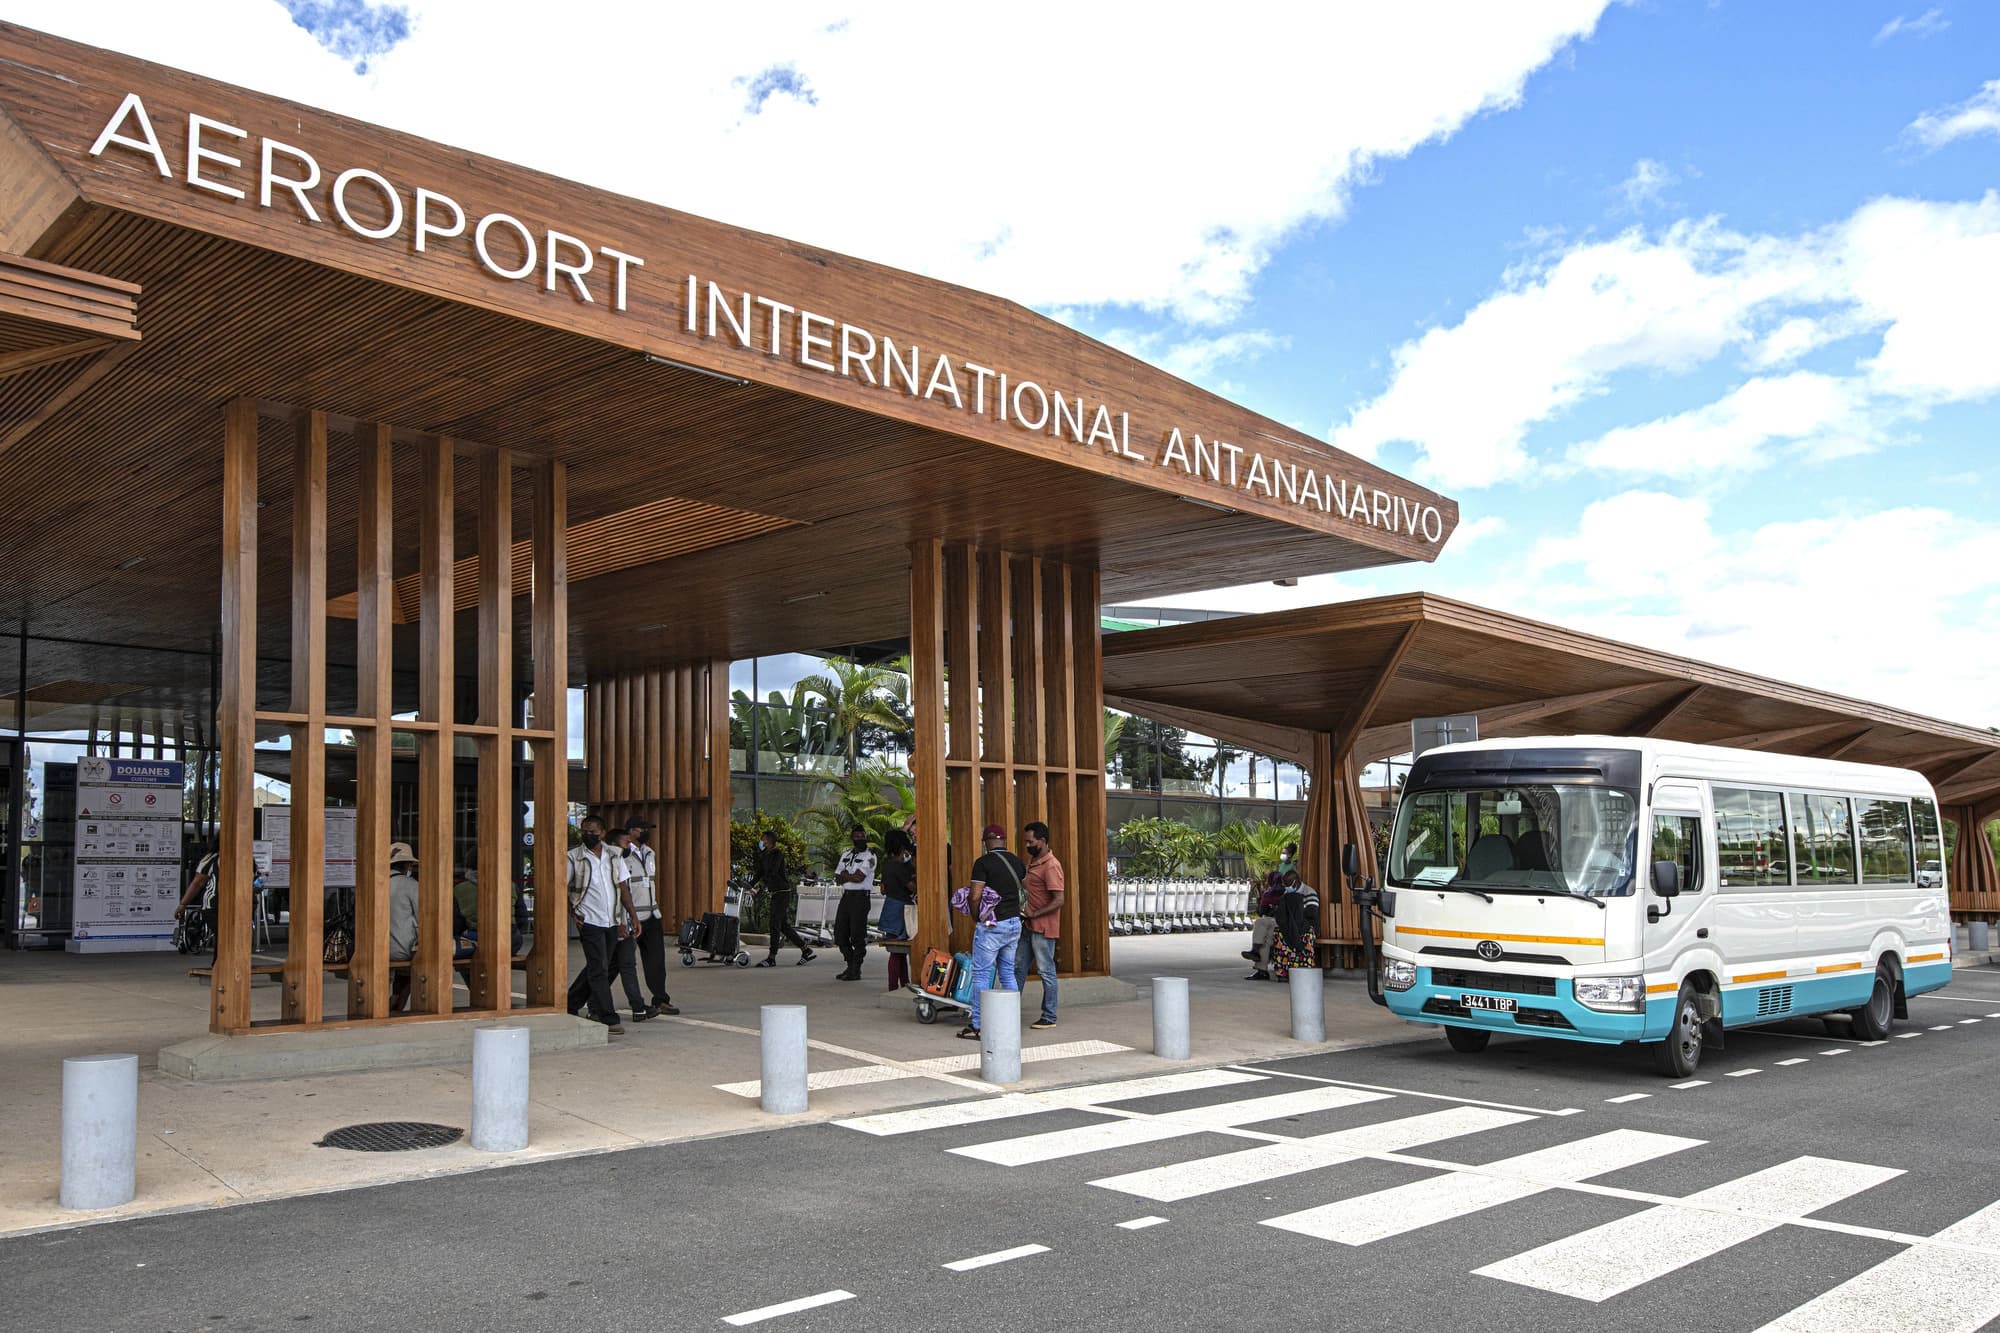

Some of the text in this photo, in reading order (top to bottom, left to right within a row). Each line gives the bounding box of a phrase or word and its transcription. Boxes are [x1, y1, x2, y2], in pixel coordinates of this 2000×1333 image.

[88, 92, 1443, 544] AEROPORT INTERNATIONAL ANTANANARIVO
[117, 766, 170, 776] DOUANES
[1465, 995, 1512, 1010] 3441 TBP
